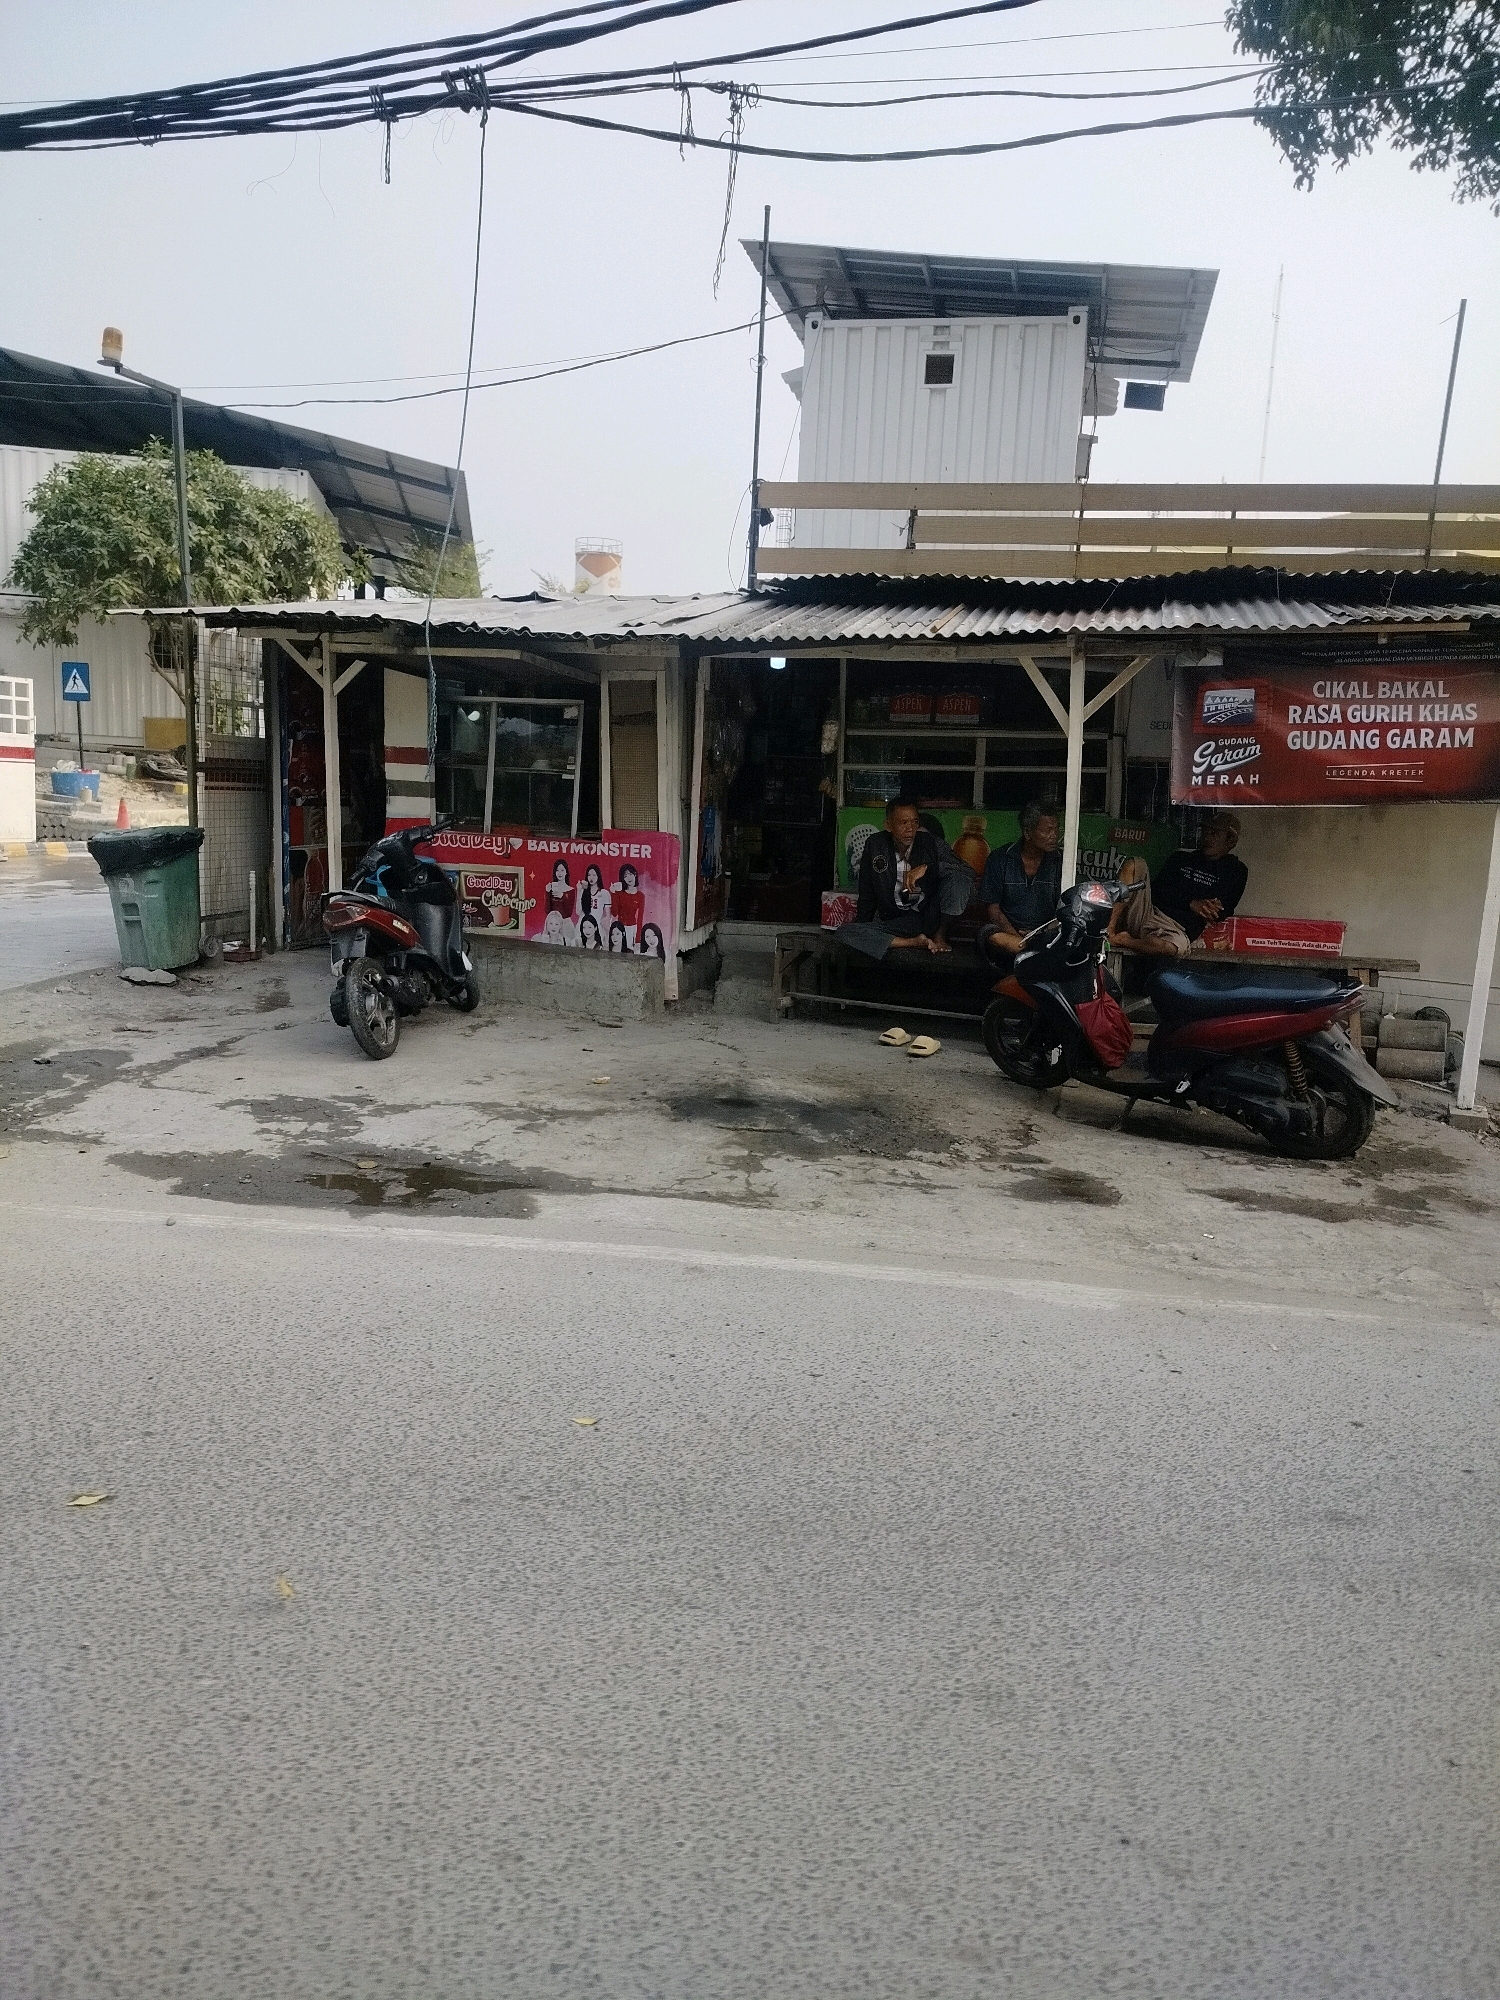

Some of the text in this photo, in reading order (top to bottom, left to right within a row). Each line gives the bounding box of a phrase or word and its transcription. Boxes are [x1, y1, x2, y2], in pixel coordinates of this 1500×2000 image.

[1312, 680, 1450, 699] CIKAL BAKAL
[895, 697, 972, 712] ASPEN ASPEN
[1288, 704, 1478, 724] RASA GURIH KHAS
[1218, 736, 1256, 746] GUDANG
[1287, 728, 1475, 750] GUDANG GARAM
[1192, 740, 1262, 773] Garam
[1192, 774, 1260, 786] MERAH
[1326, 768, 1425, 776] LEGENDA KRETEK
[1115, 828, 1146, 841] BARU!
[527, 839, 652, 859] BABYMONSTER
[1076, 865, 1113, 880] ARUM
[467, 875, 512, 892] Good Day
[482, 890, 537, 912] Chococinno
